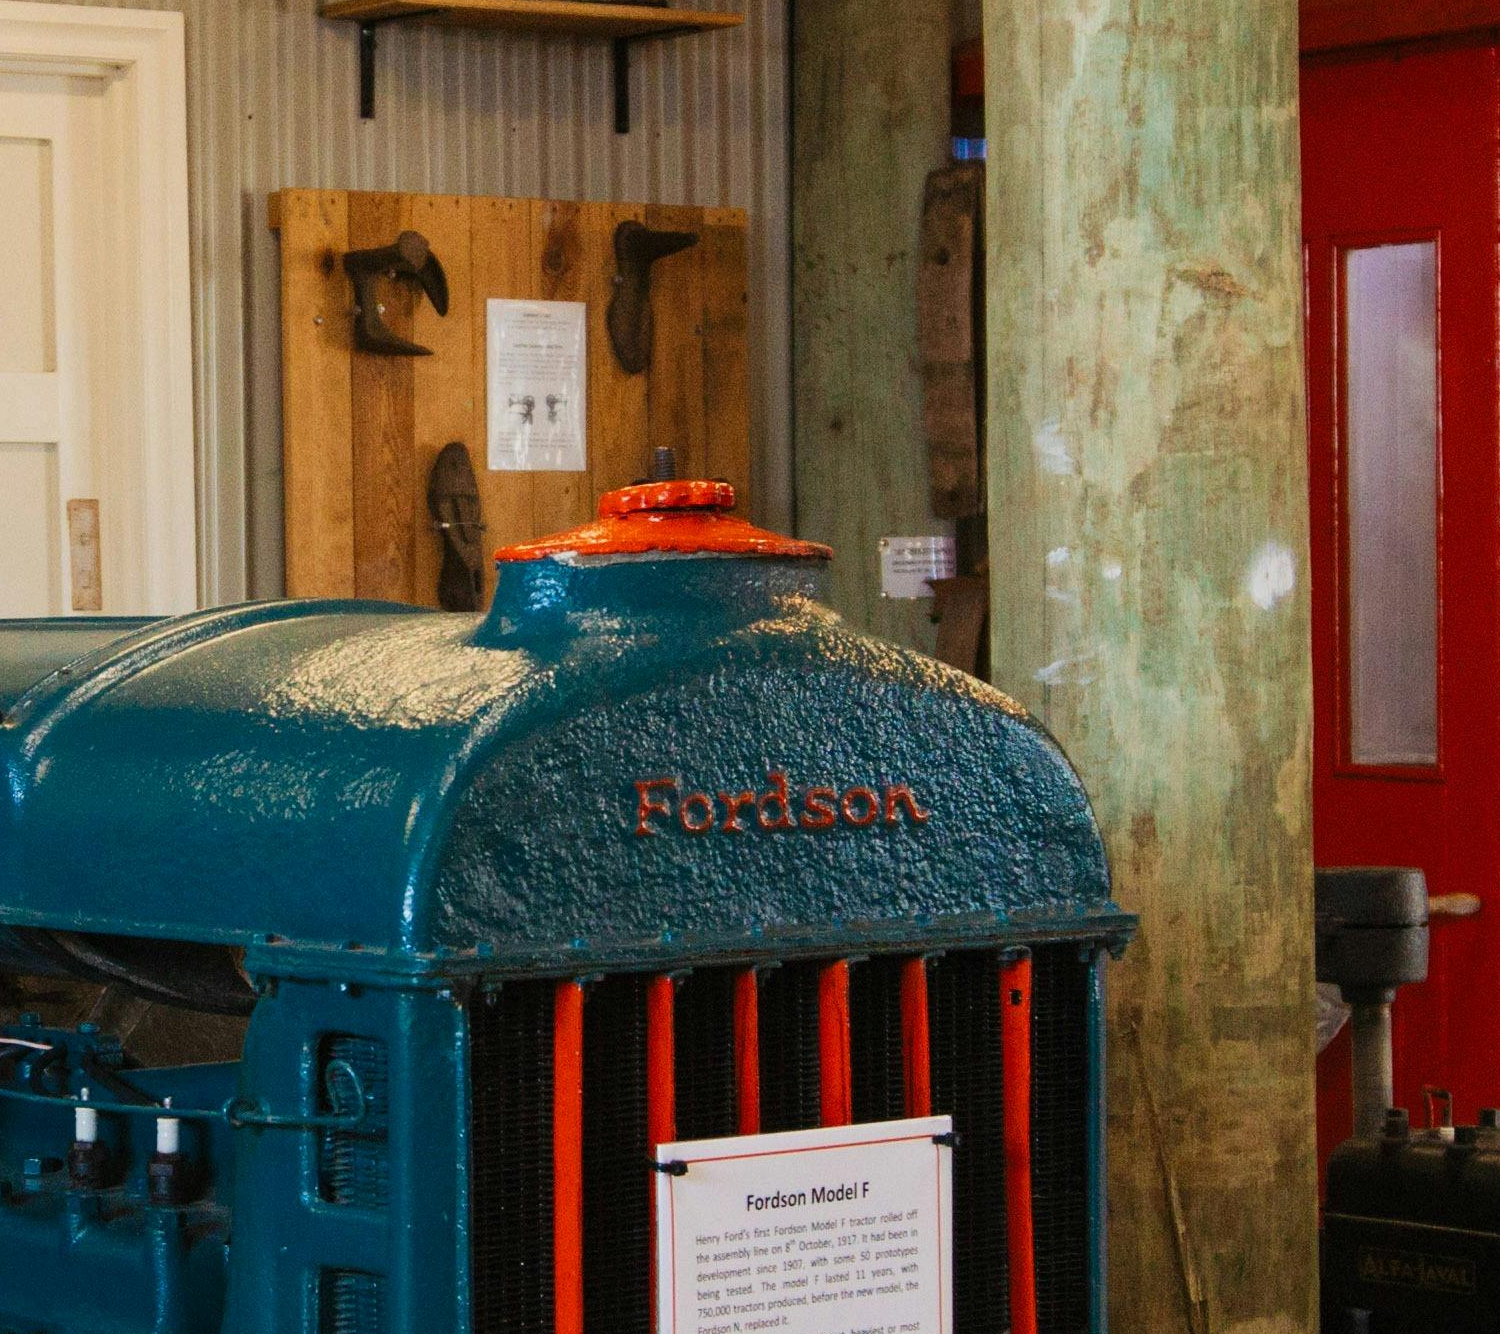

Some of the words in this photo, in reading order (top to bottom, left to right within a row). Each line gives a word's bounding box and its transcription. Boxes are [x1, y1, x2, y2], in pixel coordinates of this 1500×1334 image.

[633, 770, 930, 837] Fordson
[746, 1190, 806, 1211] Fordson
[811, 1181, 857, 1204] Model
[861, 1180, 869, 1198] F
[695, 1235, 720, 1245] Henry
[724, 1228, 749, 1241] Ford's
[753, 1227, 770, 1237] first
[774, 1224, 807, 1235] Fordson
[811, 1219, 837, 1231] Model
[849, 1216, 876, 1227] tractor
[880, 1211, 902, 1223] rolled
[906, 1208, 917, 1220] off
[696, 1253, 710, 1264] the
[712, 1247, 751, 1261] assembly
[753, 1246, 768, 1256] line
[771, 1245, 782, 1254] on
[870, 1230, 885, 1241] had
[887, 1230, 908, 1239] been
[696, 1266, 750, 1282] development
[756, 1264, 777, 1274] since
[810, 1255, 828, 1267] with
[833, 1254, 855, 1264] some
[860, 1249, 870, 1261] 50
[875, 1246, 918, 1260] prototypes
[696, 1289, 720, 1300] being
[761, 1281, 776, 1291] The
[782, 1275, 808, 1288] model
[825, 1270, 849, 1283] lasted
[855, 1269, 865, 1279] 11
[900, 1262, 918, 1273] with
[733, 1302, 765, 1313] tractors
[811, 1291, 838, 1303] before
[840, 1288, 854, 1299] the
[856, 1287, 874, 1297] new
[905, 1280, 918, 1290] the
[744, 1315, 779, 1330] replaced
[887, 1325, 896, 1334] or
[899, 1321, 919, 1332] most
